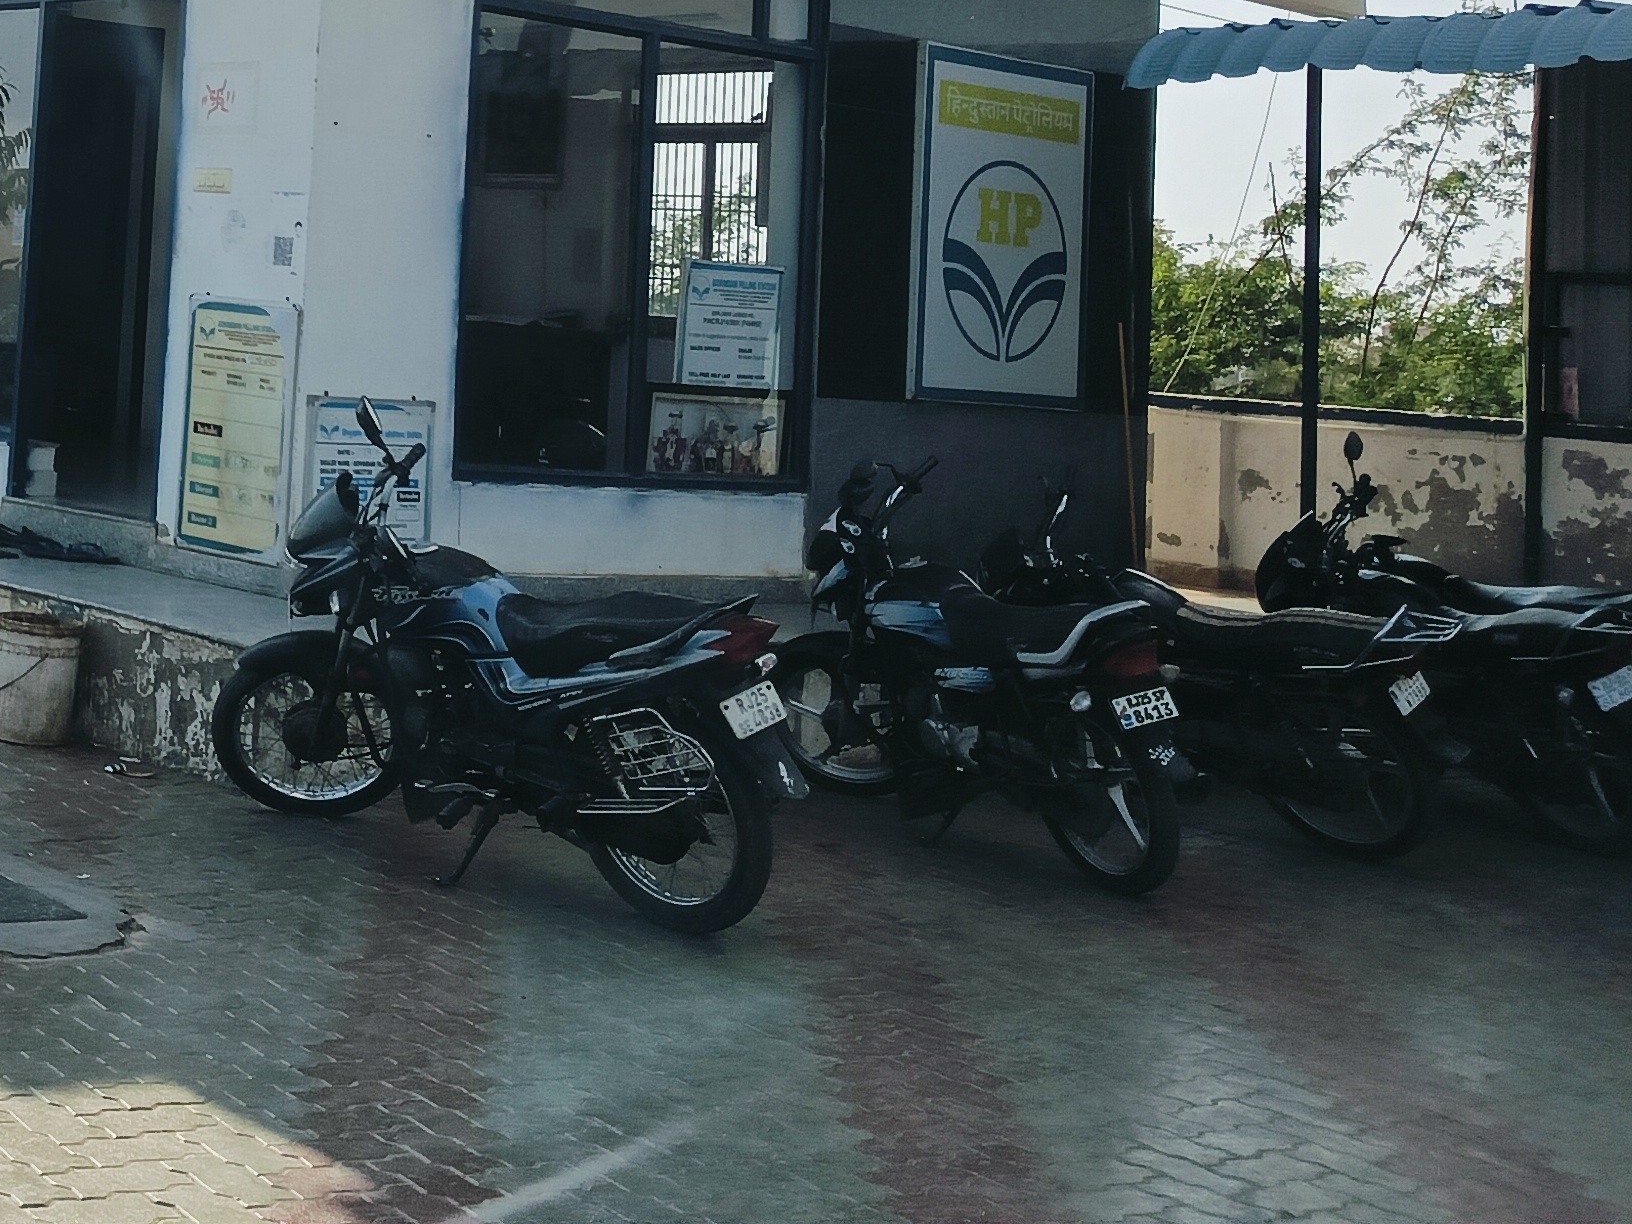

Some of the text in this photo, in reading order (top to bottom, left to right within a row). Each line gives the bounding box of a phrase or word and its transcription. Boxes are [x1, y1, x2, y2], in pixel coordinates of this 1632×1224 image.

[946, 86, 1074, 134] हिन्दुस्तान पेट्रोलियम
[976, 187, 1043, 248] HP
[1132, 701, 1174, 724] 8413
